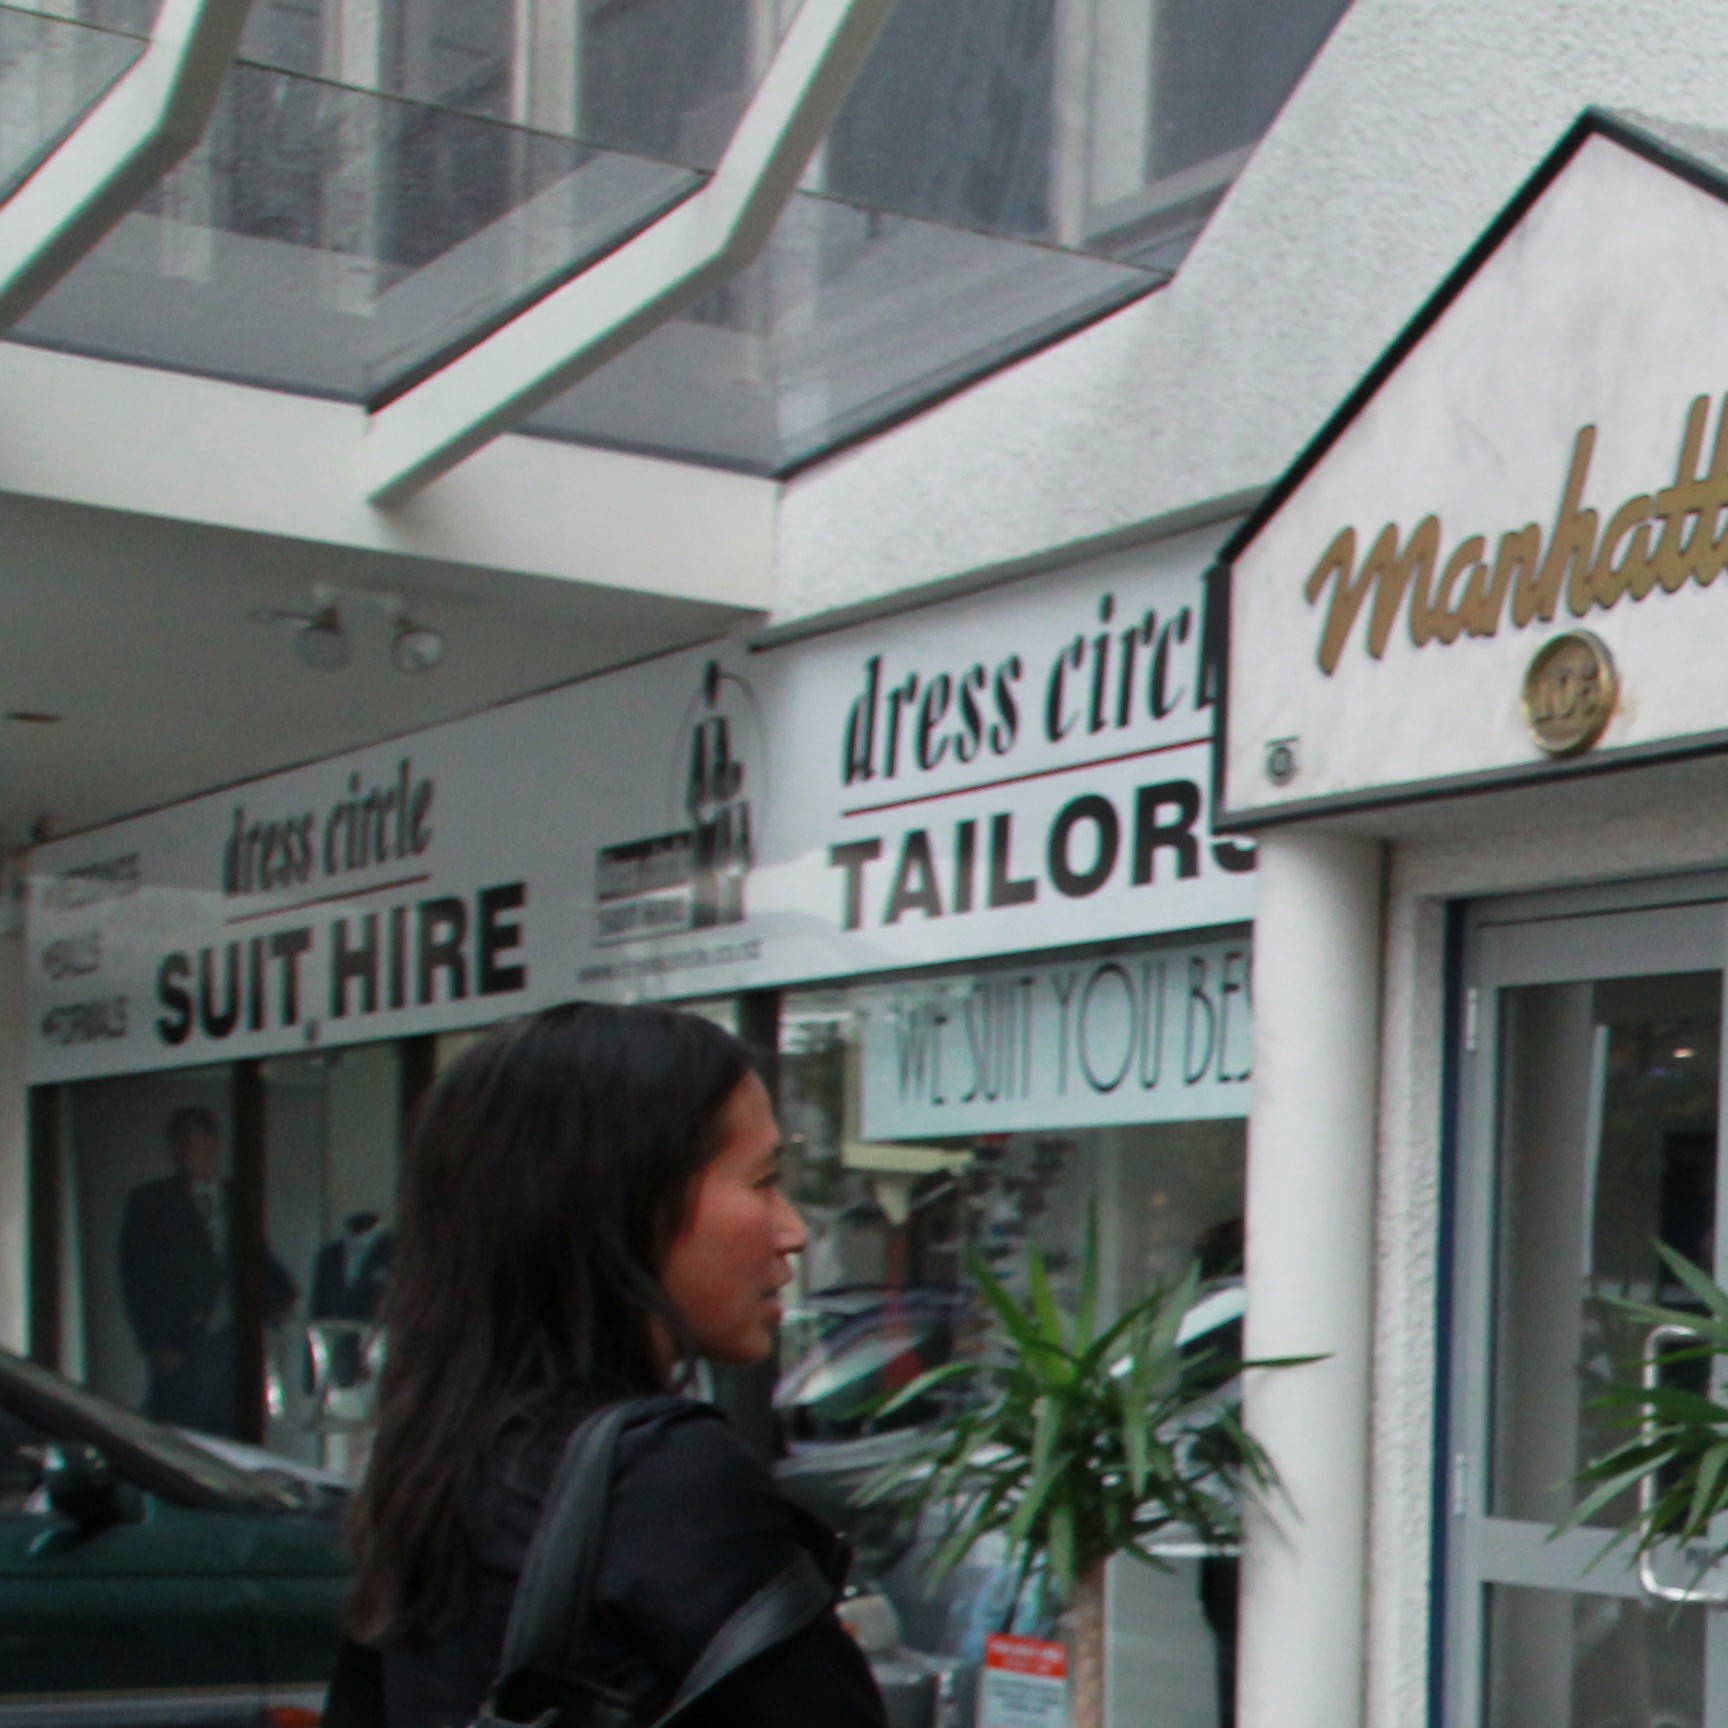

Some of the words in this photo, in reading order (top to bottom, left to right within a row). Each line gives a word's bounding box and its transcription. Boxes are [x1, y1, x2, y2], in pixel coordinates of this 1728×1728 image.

[840, 654, 1024, 788] dress
[222, 806, 312, 898] dress
[323, 757, 436, 878] circle
[154, 925, 314, 1047] SUIT
[329, 881, 528, 1020] HIRE
[898, 995, 950, 1105] WE
[1048, 959, 1166, 1096] YOU
